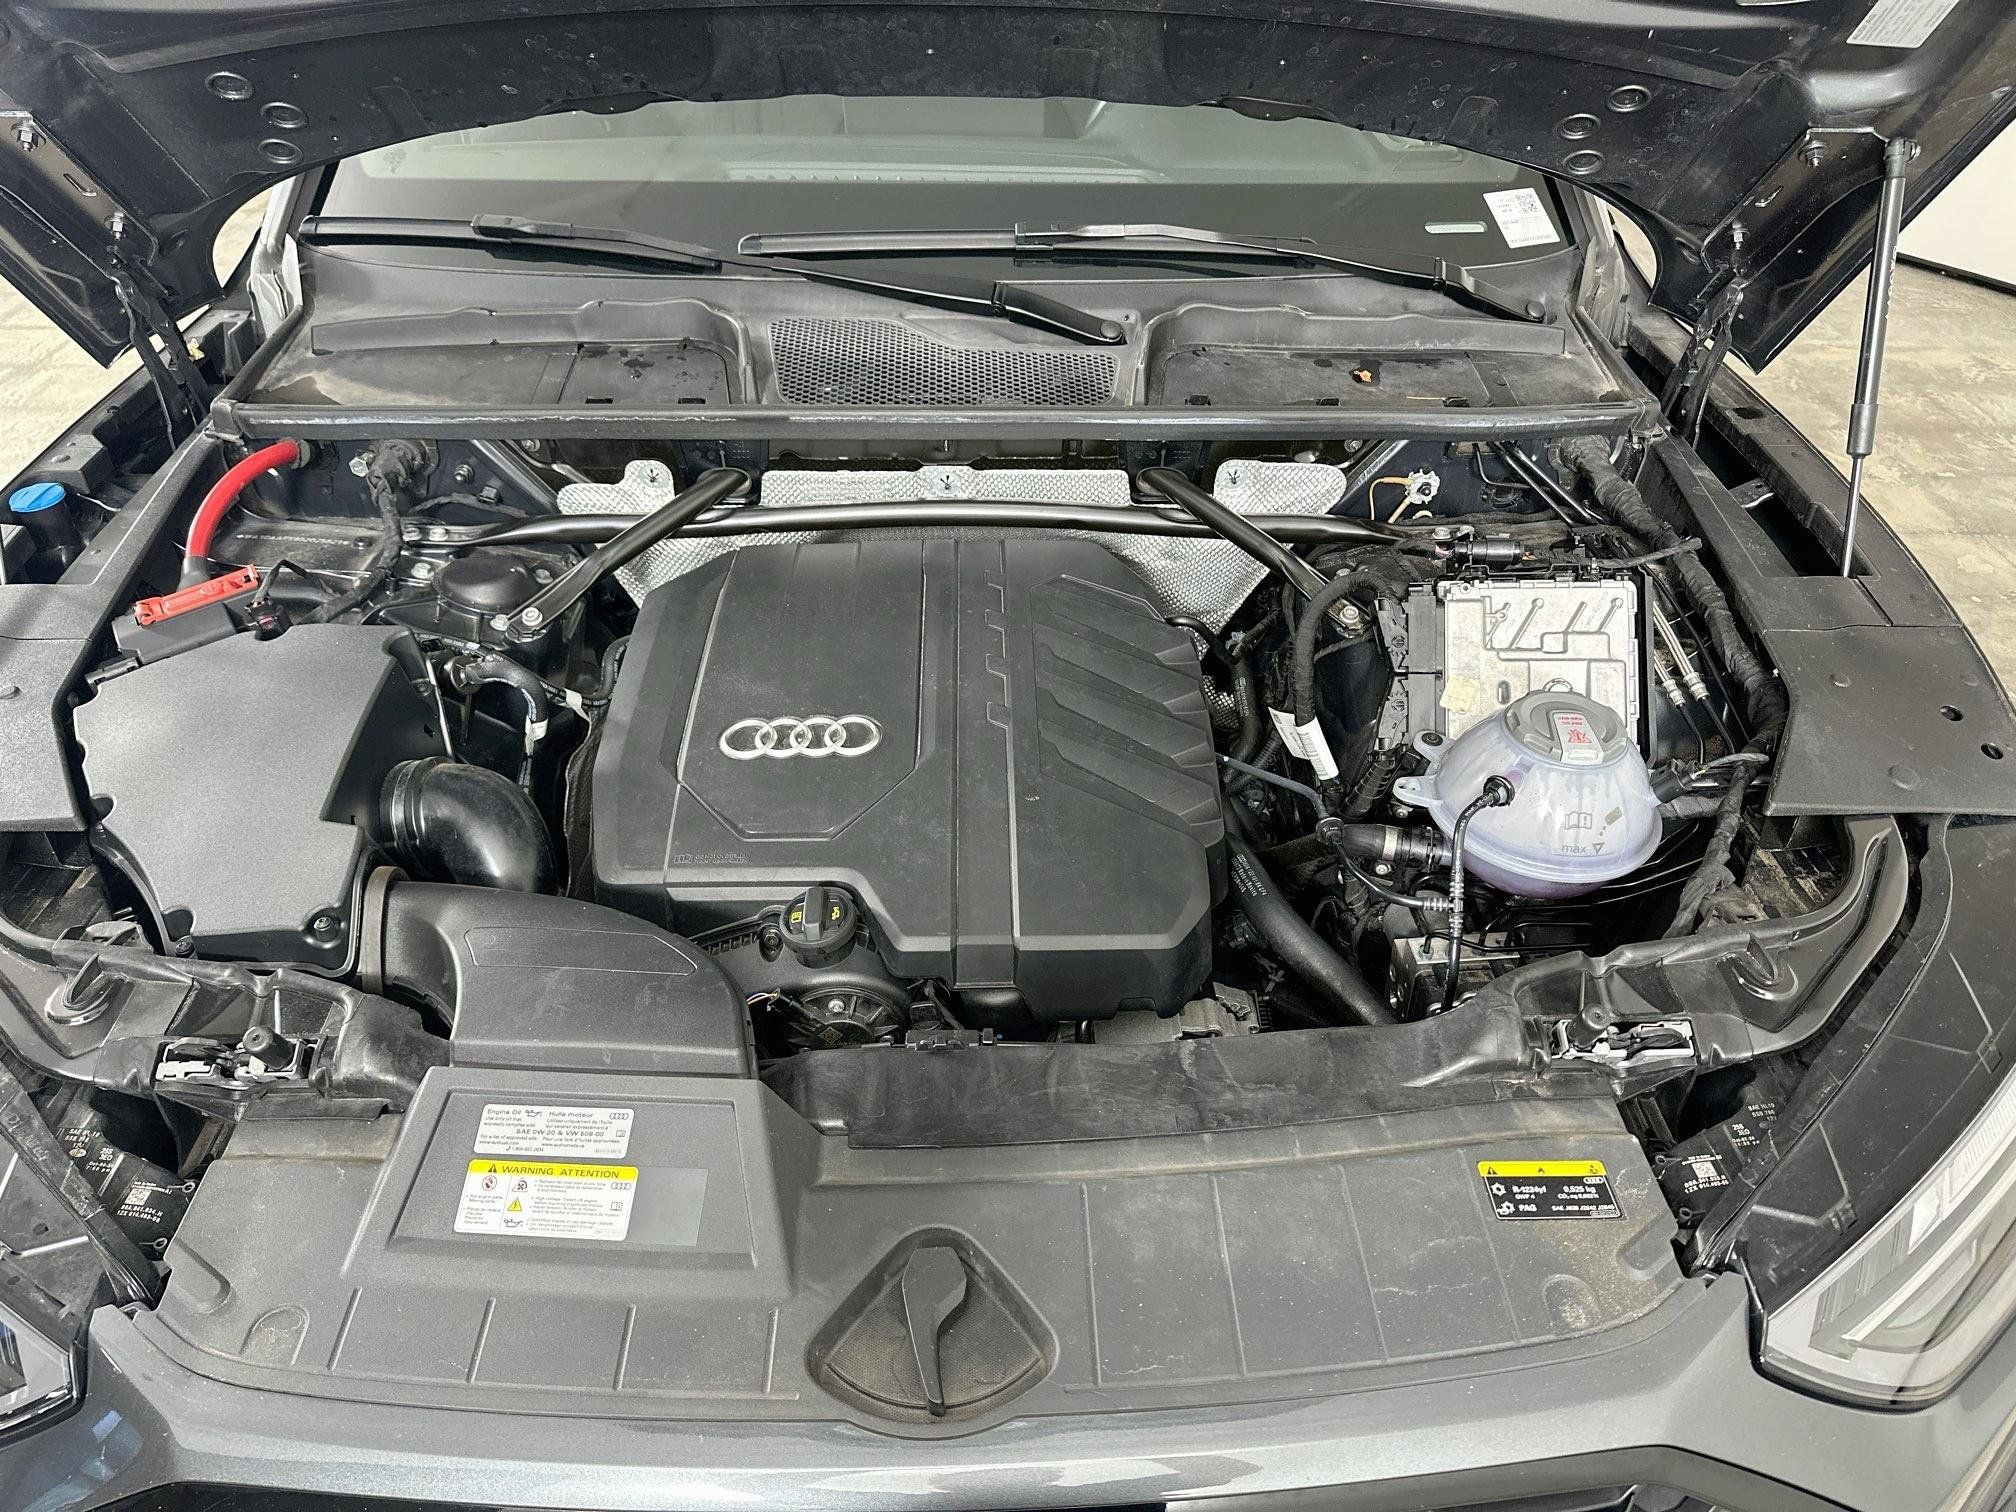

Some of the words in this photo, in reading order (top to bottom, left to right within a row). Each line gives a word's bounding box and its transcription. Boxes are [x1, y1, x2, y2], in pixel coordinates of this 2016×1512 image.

[1561, 845, 1586, 854] max
[502, 1166, 554, 1175] WARNING
[560, 1168, 620, 1178] ATTENTION
[1586, 1186, 1596, 1194] kg
